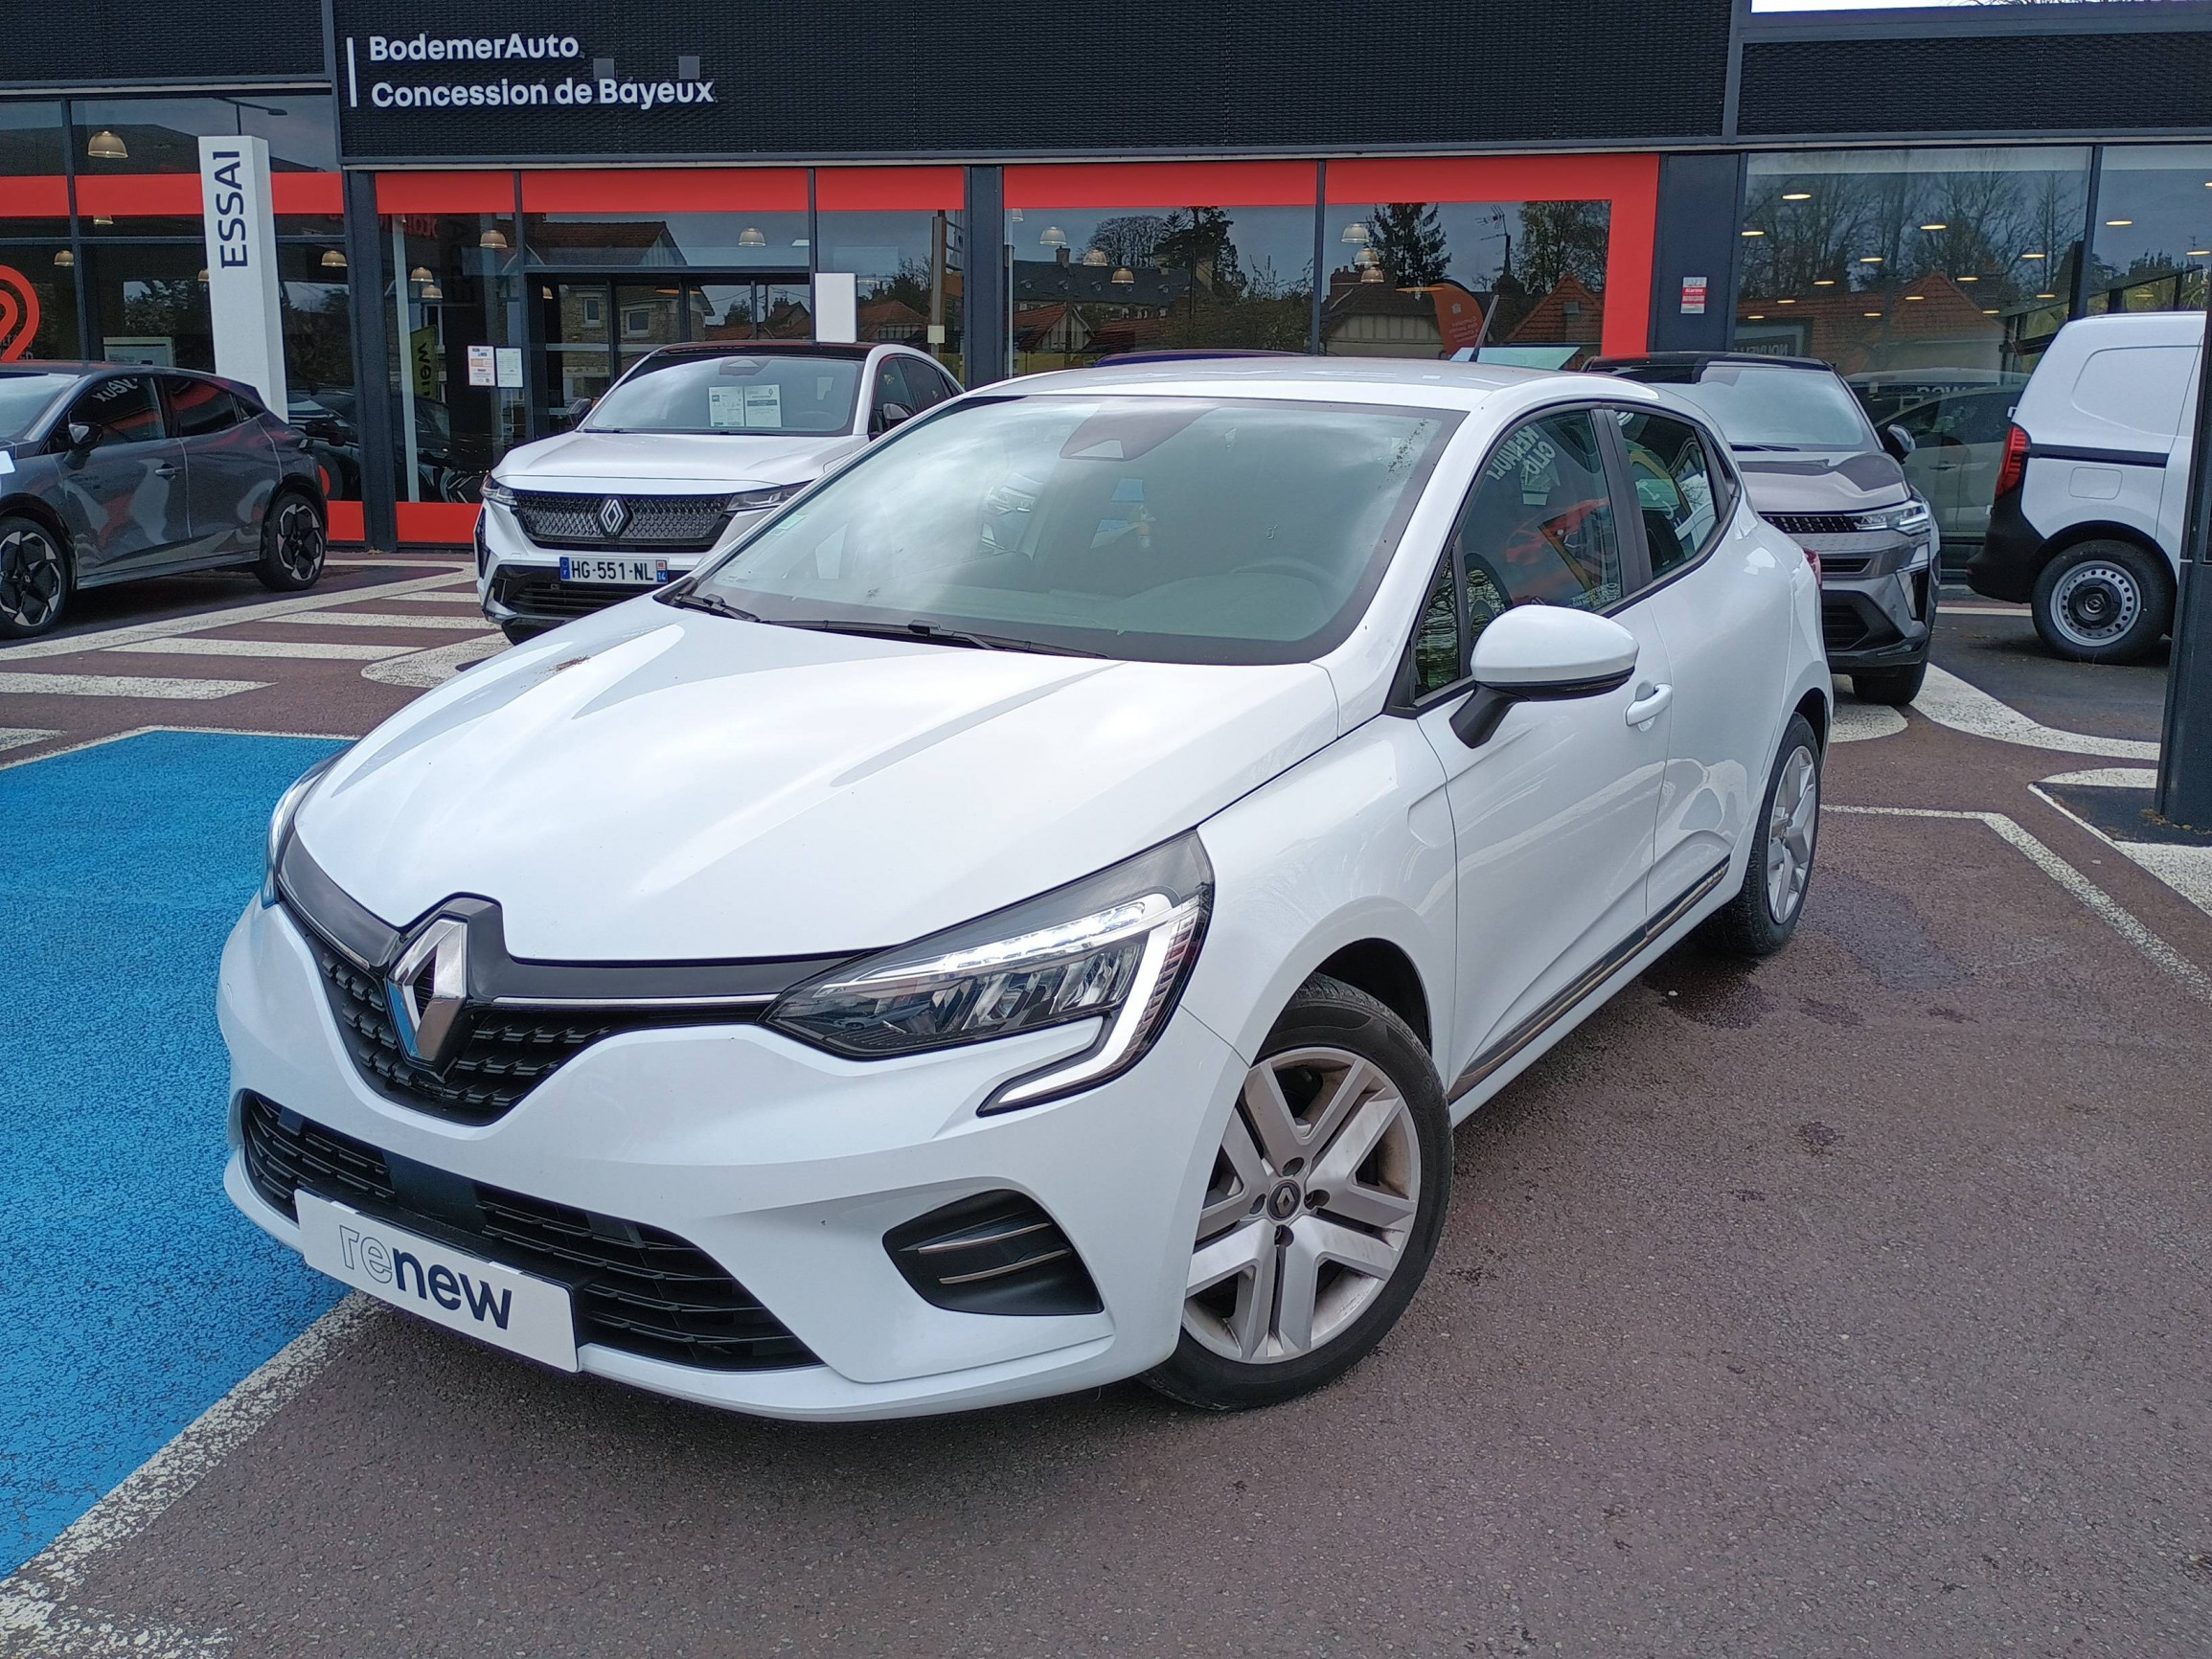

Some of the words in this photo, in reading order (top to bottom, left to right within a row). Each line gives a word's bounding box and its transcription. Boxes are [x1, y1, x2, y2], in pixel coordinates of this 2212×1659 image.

[369, 33, 580, 61] BodemerAuto
[371, 78, 548, 107] Concession
[554, 78, 595, 105] de
[599, 78, 715, 110] Bayeux
[212, 150, 249, 269] ESSAI
[571, 560, 654, 581] HG-551-NL
[338, 1224, 513, 1331] renew
